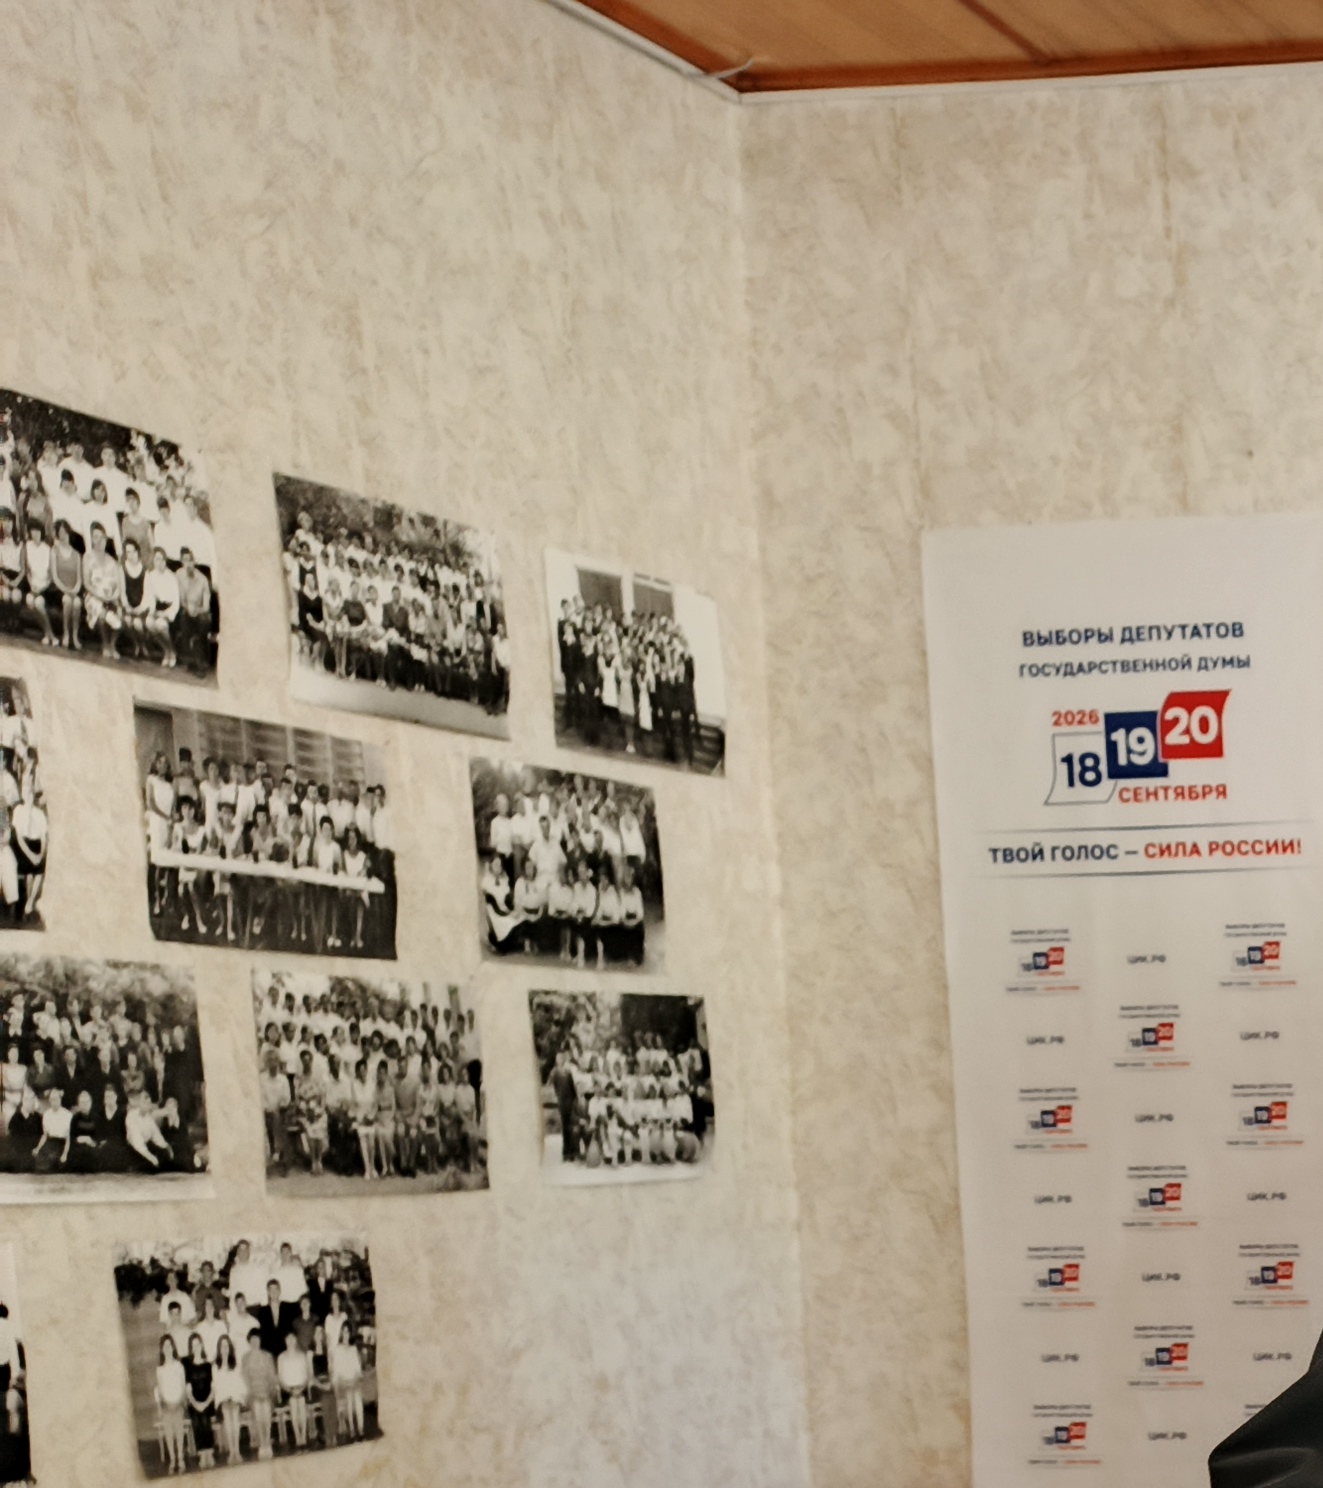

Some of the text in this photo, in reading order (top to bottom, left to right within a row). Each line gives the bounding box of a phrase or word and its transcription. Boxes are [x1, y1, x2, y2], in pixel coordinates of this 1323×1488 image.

[1022, 622, 1244, 648] ВЫБОРЫ ДЕПУТАТОВ
[1019, 654, 1251, 679] ГОСУДАРСТВЕННОЙ ДУМЫ
[1052, 709, 1100, 727] 2026
[1060, 705, 1219, 788] 18 19 20
[1118, 783, 1228, 804] СЕНТЯБРЯ
[988, 843, 1045, 864] ТВОЙ
[1051, 844, 1119, 861] ГОЛОС
[1143, 841, 1202, 859] СИЛА
[1208, 839, 1302, 857] РОССИИ!
